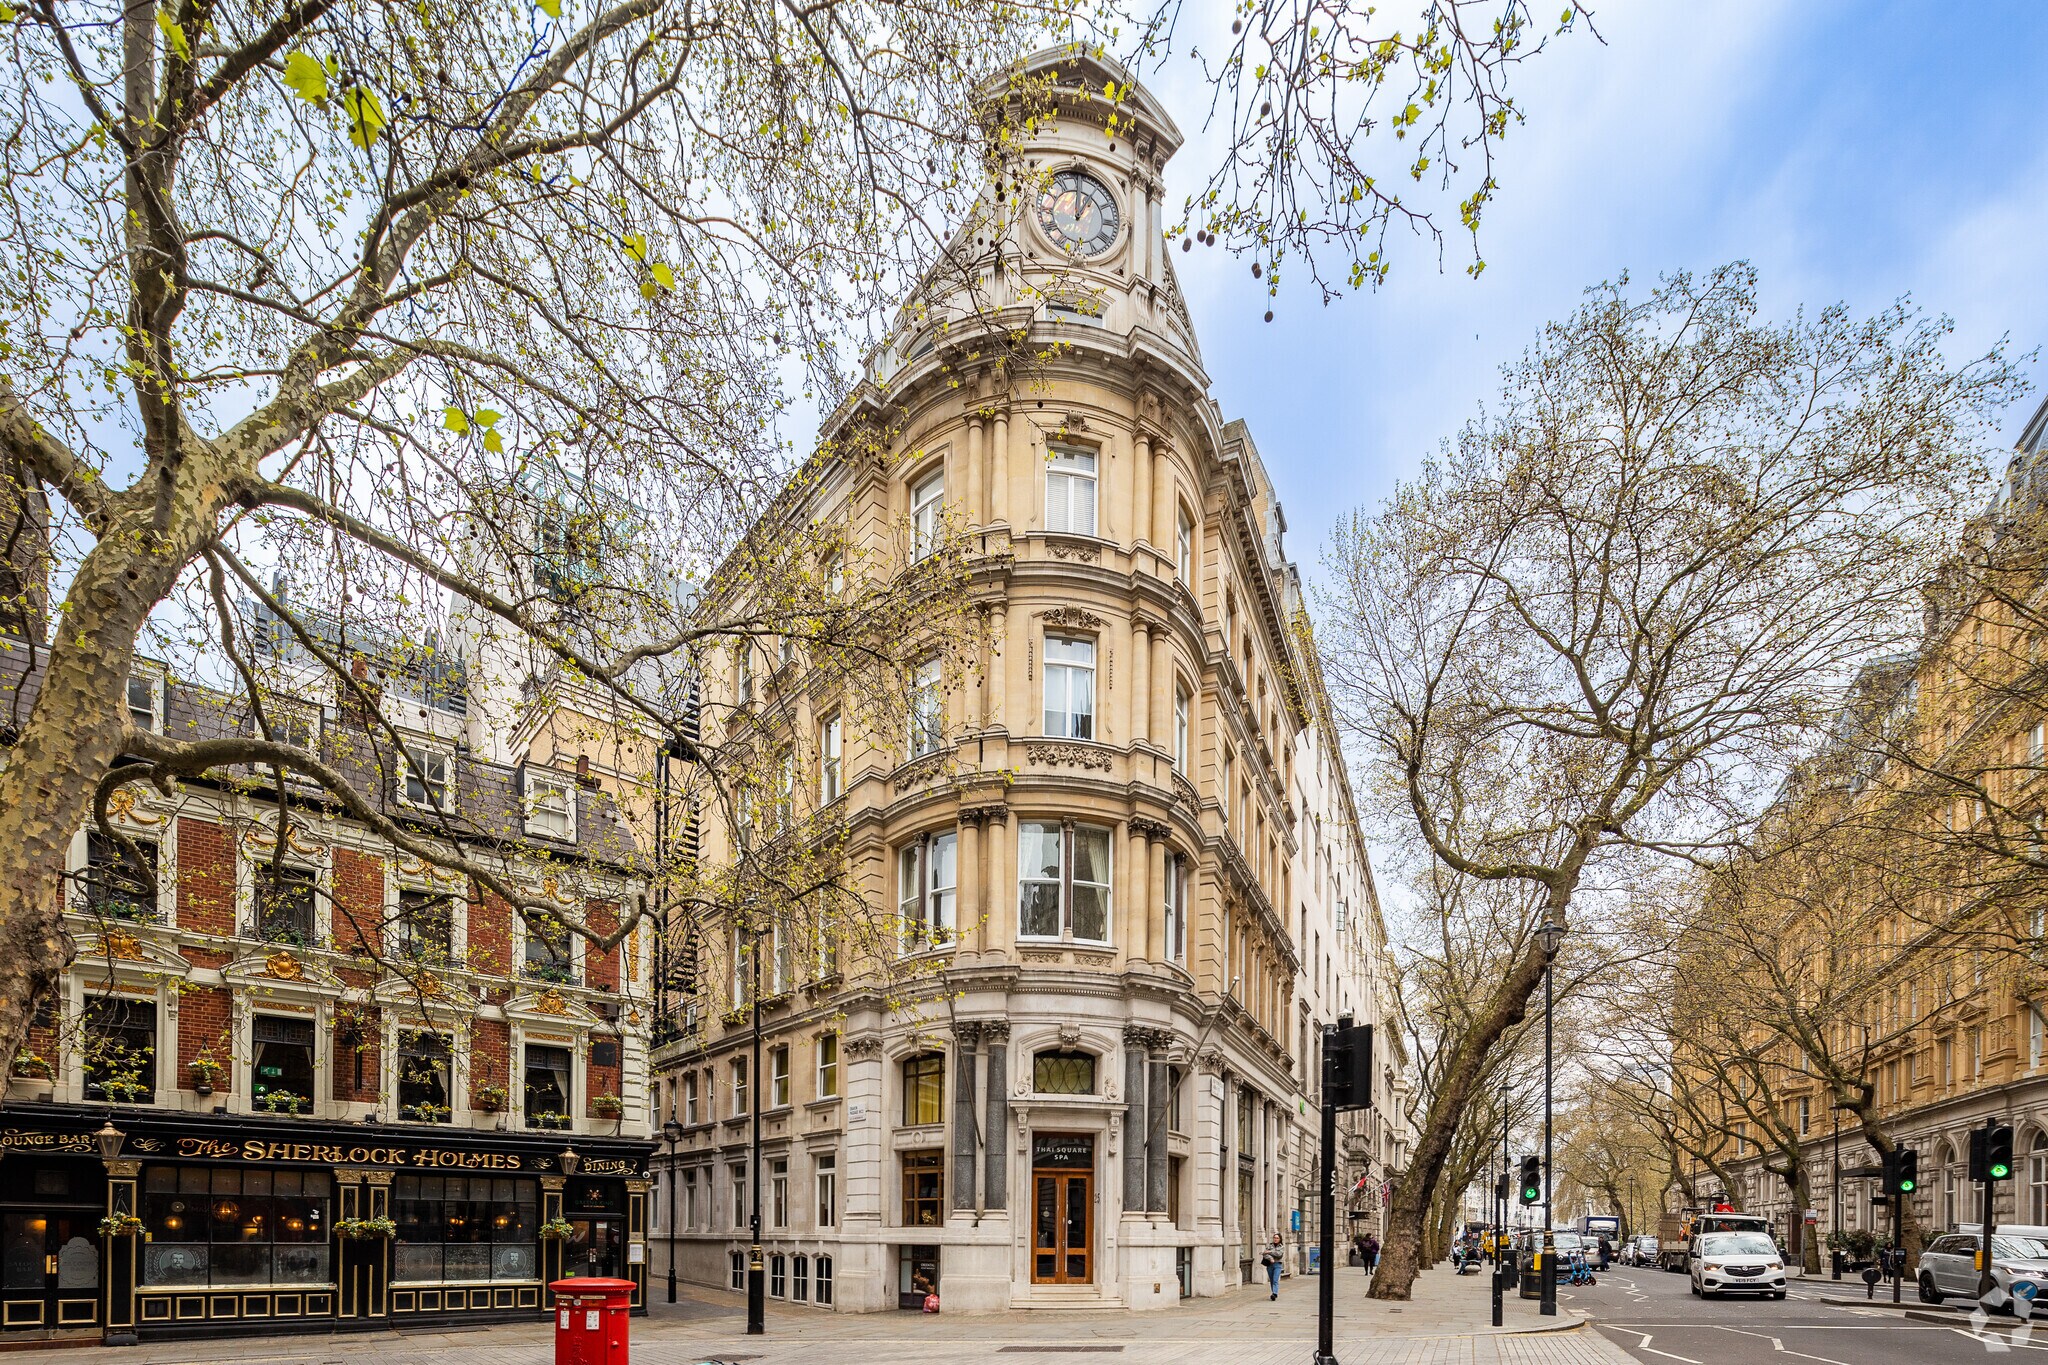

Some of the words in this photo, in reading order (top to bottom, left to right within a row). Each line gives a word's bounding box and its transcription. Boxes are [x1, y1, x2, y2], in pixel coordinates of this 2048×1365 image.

[0, 1135, 54, 1146] OUNGE
[59, 1134, 91, 1144] BAR
[176, 1138, 239, 1158] The
[242, 1140, 406, 1164] SHERLOCK
[413, 1149, 521, 1169] HOLMES
[584, 1161, 626, 1171] DINING
